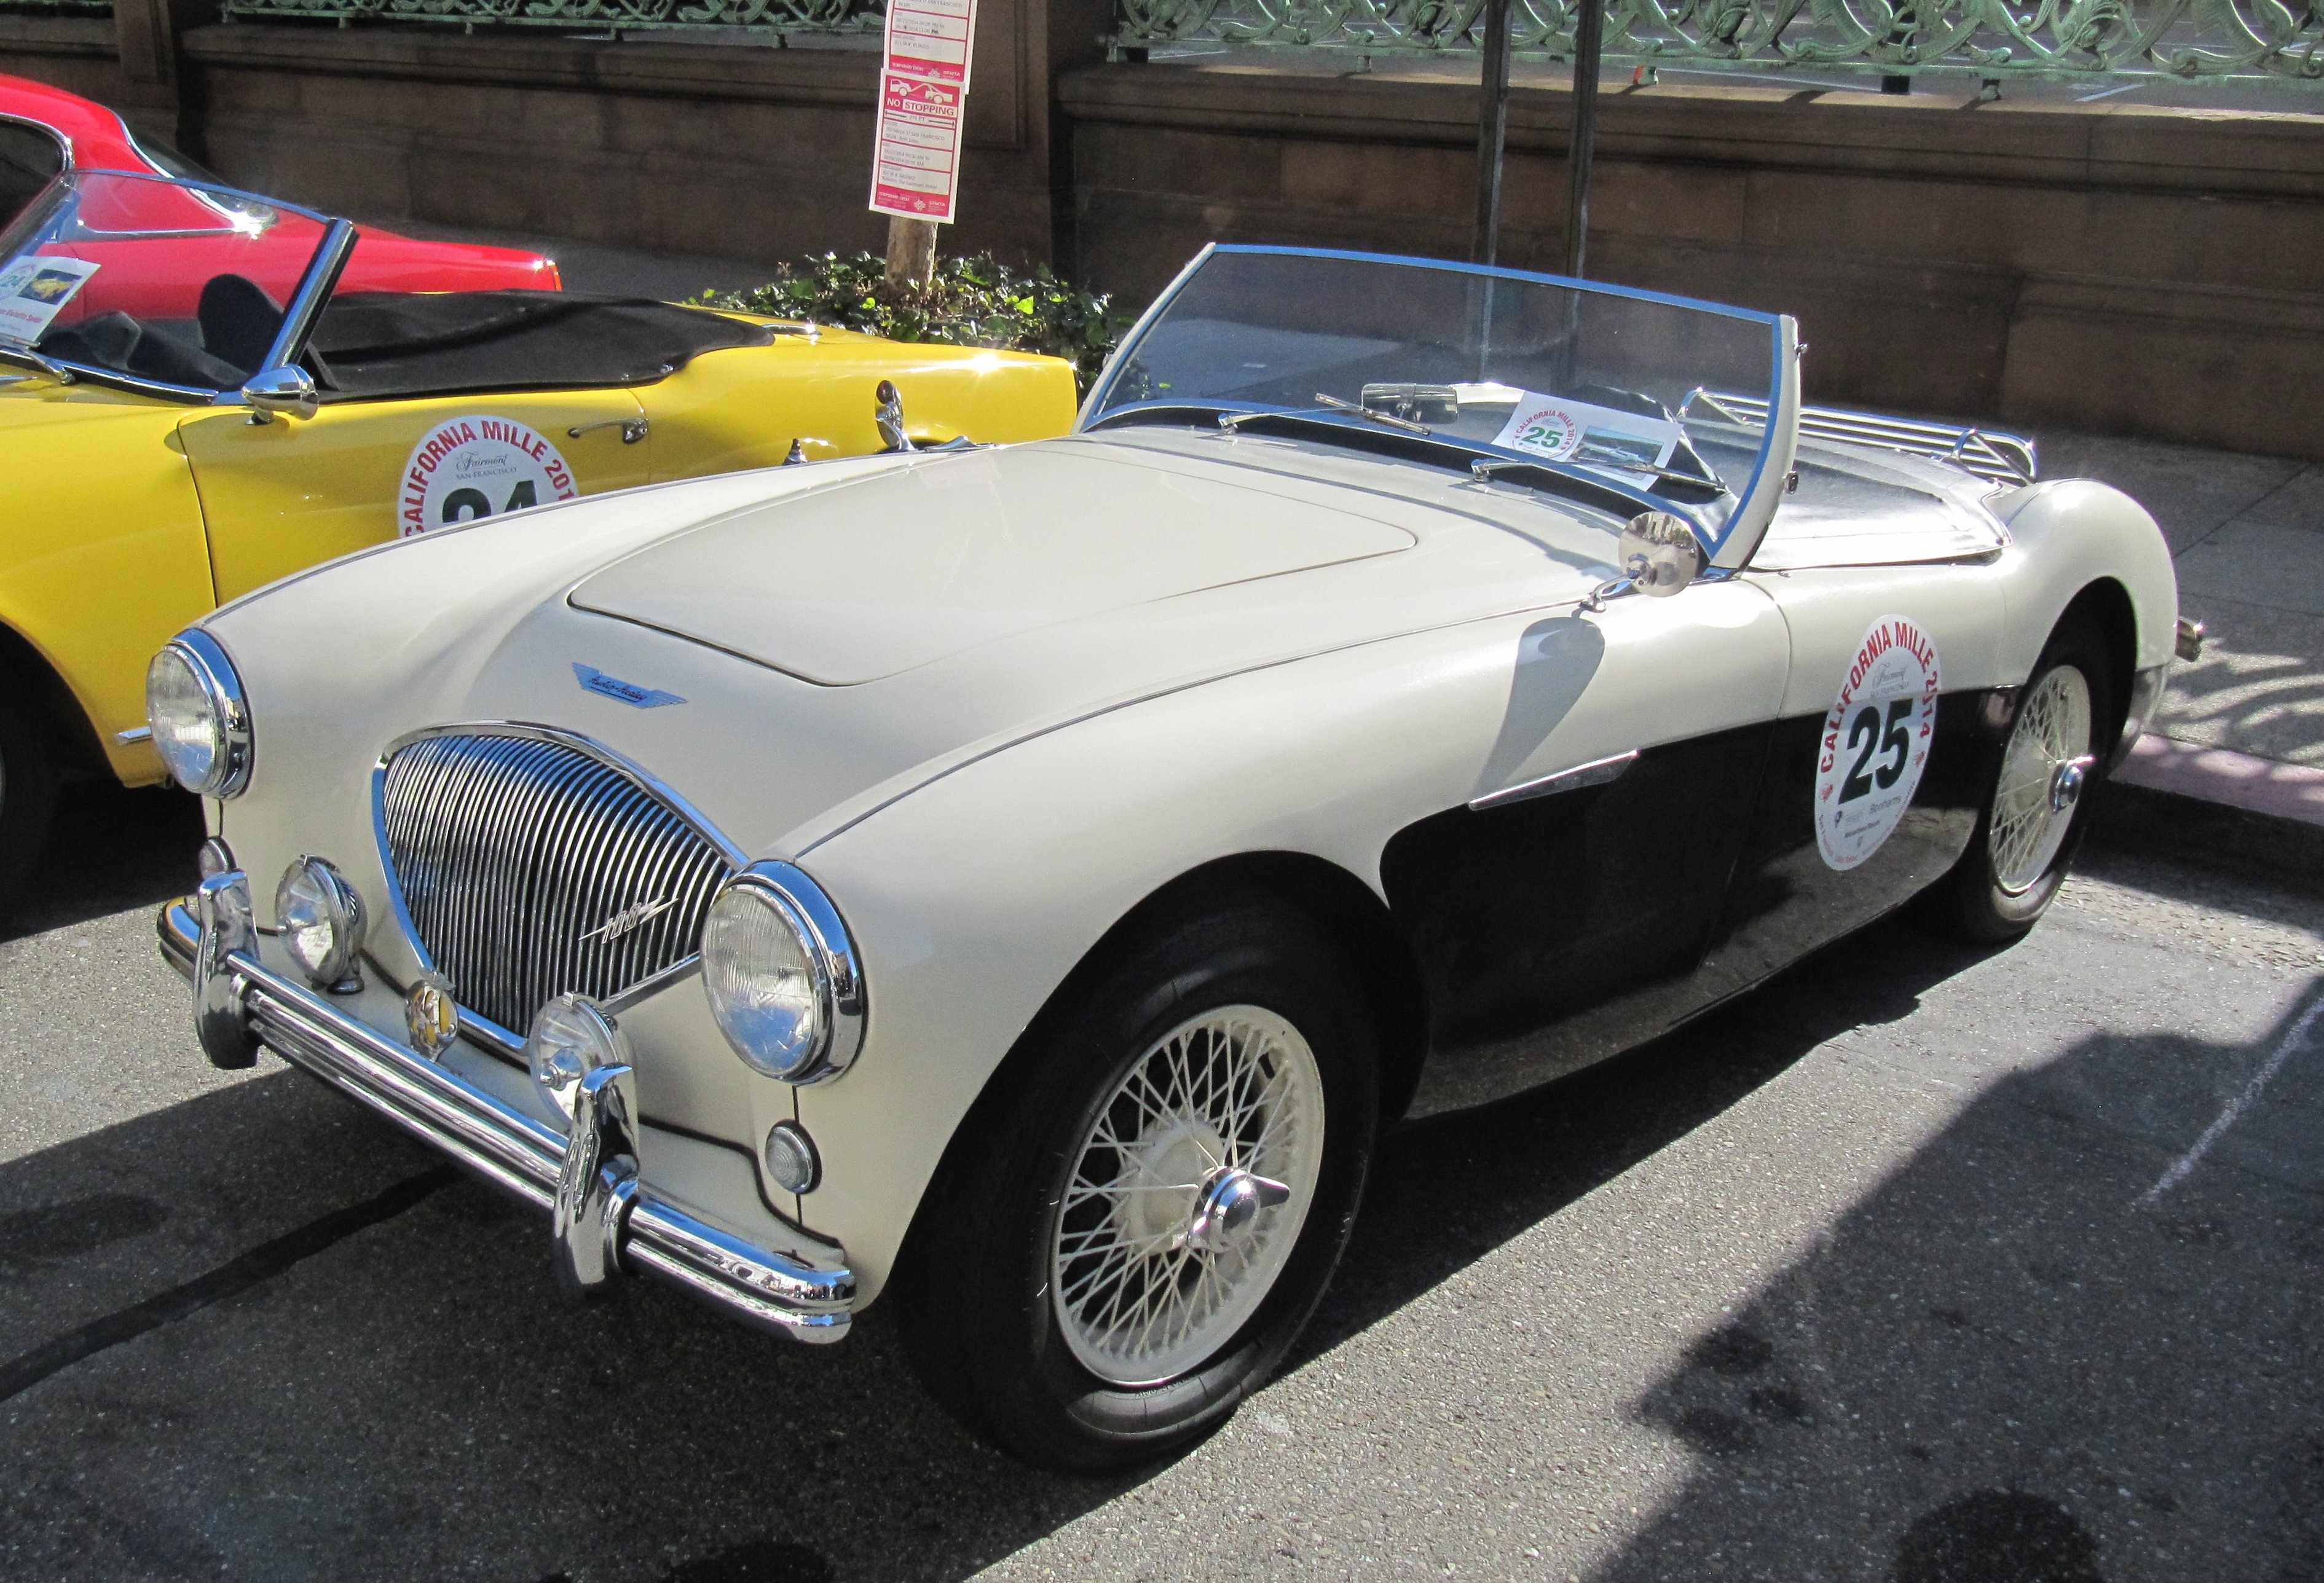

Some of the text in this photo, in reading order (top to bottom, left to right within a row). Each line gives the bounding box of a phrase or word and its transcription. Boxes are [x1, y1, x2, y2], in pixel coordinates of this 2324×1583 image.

[887, 98, 954, 116] NO STOPPING
[1516, 410, 1556, 433] CALIFORNIA
[1557, 412, 1574, 428] MILLE
[1521, 426, 1564, 448] 25
[1565, 429, 1575, 445] 2014
[456, 451, 508, 473] Fairmont
[404, 422, 478, 537] CALIFORNIA
[481, 420, 548, 463] MILLE
[457, 467, 516, 481] SAN FRANCISCO
[1821, 624, 1891, 774] CALIFORNIA
[1894, 621, 1934, 674] MILLE
[1838, 698, 1913, 806] 25
[602, 902, 642, 944] 100
